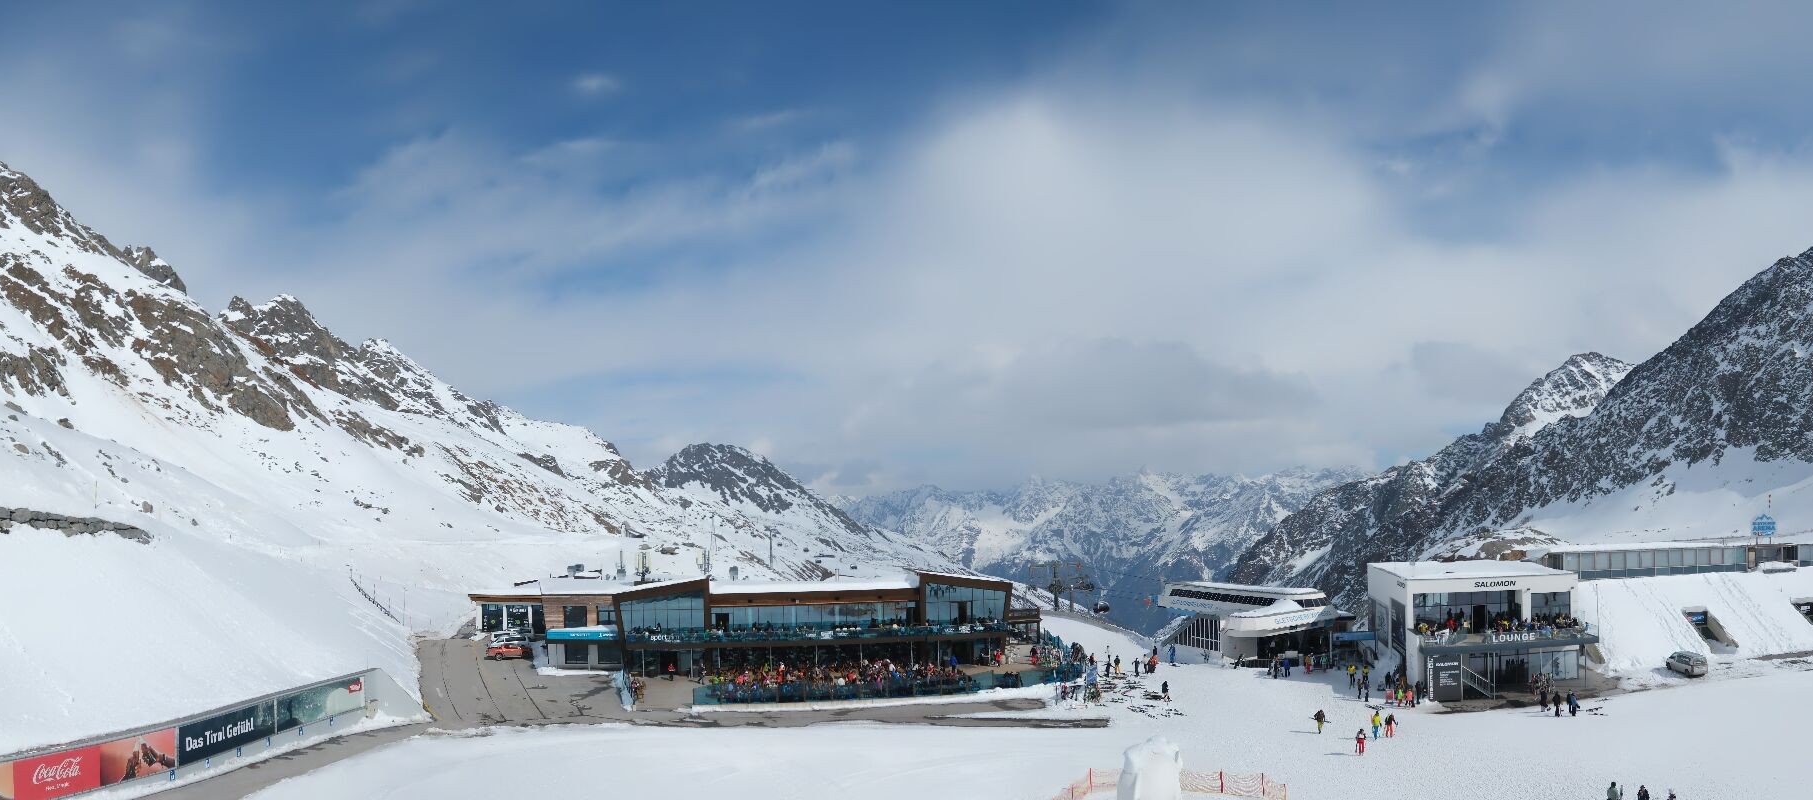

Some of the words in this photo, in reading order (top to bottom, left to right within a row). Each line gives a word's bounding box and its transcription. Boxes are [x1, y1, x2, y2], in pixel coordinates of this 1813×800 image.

[1474, 580, 1516, 588] SALOMON
[1492, 632, 1536, 643] LOUNGE
[185, 736, 204, 752] Das
[205, 726, 226, 746] Tirol
[227, 717, 255, 739] Gefühl
